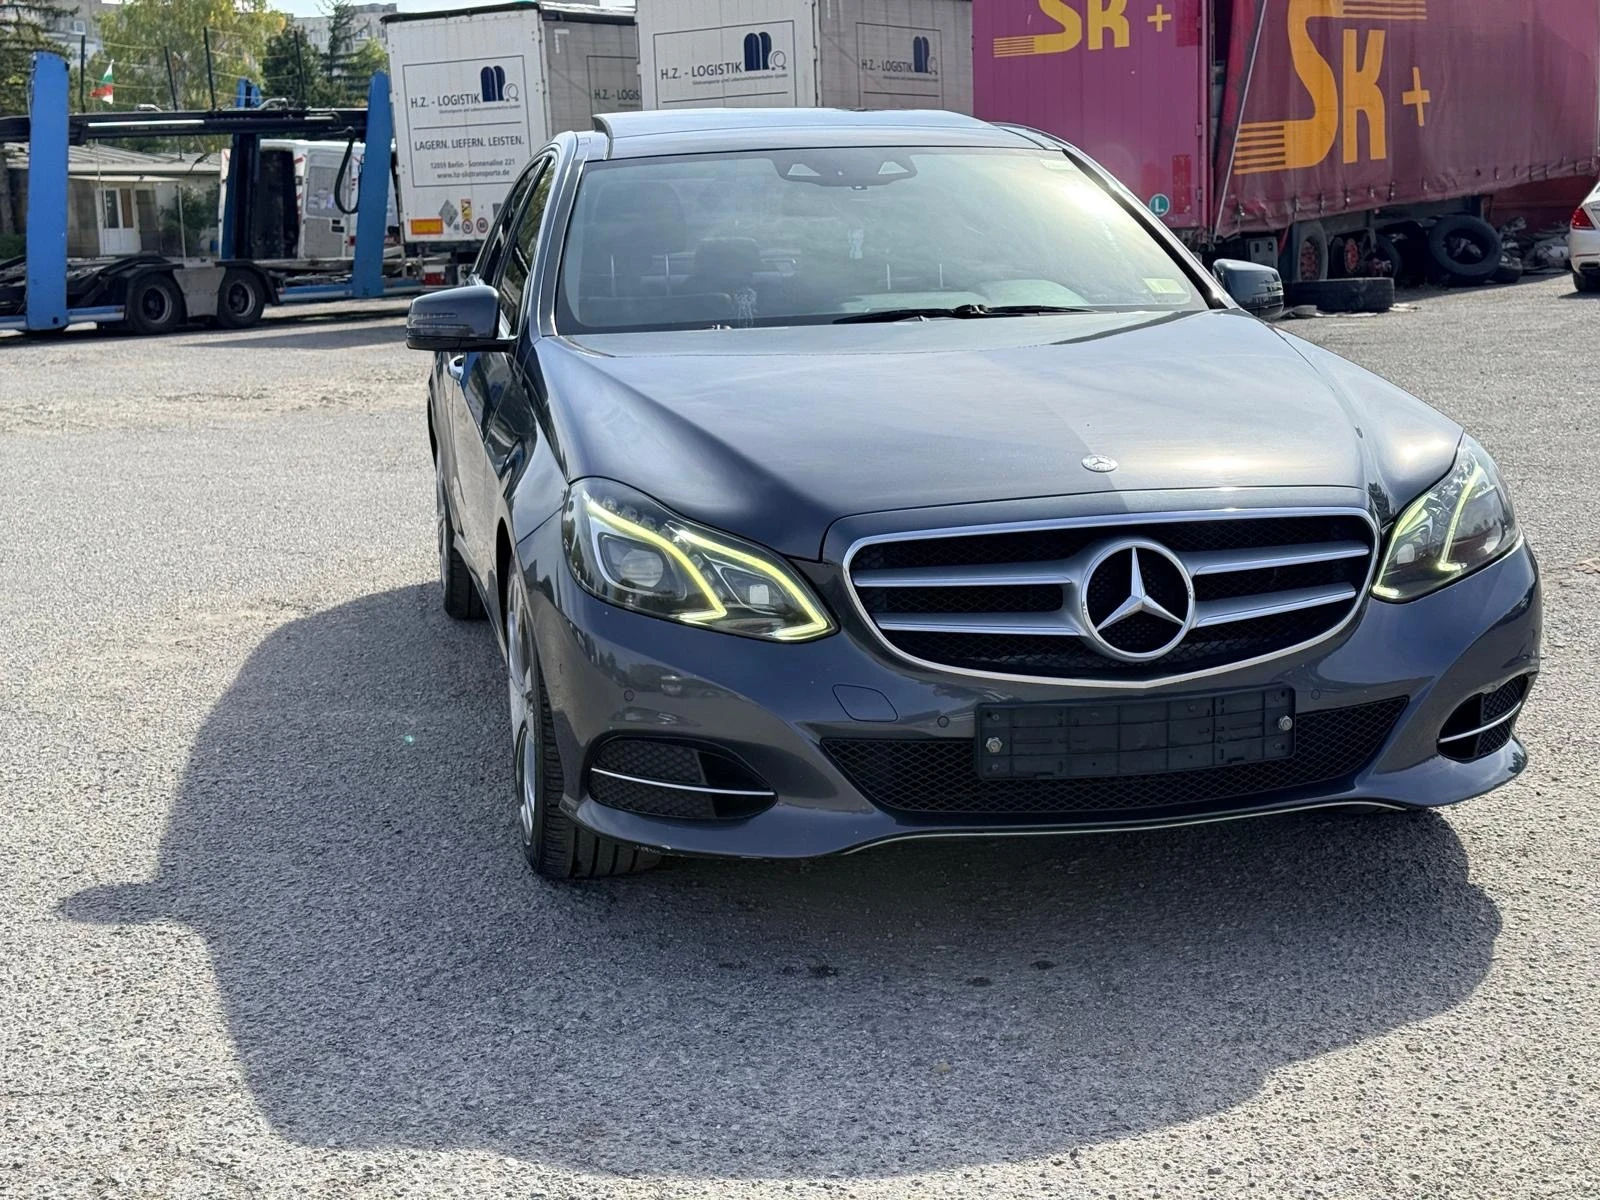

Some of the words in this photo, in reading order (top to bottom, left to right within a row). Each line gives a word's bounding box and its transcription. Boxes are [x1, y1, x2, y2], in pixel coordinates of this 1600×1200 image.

[660, 67, 681, 80] H.Z.
[691, 62, 742, 78] LOGISTIK
[881, 60, 913, 73] LOGISTIK
[410, 96, 430, 109] H.Z.
[437, 93, 481, 107] LOGISTIK
[414, 139, 450, 151] LAGERN.
[451, 137, 487, 149] LIEFERN.
[488, 135, 525, 147] LEISTEN.
[1155, 198, 1164, 212] L
